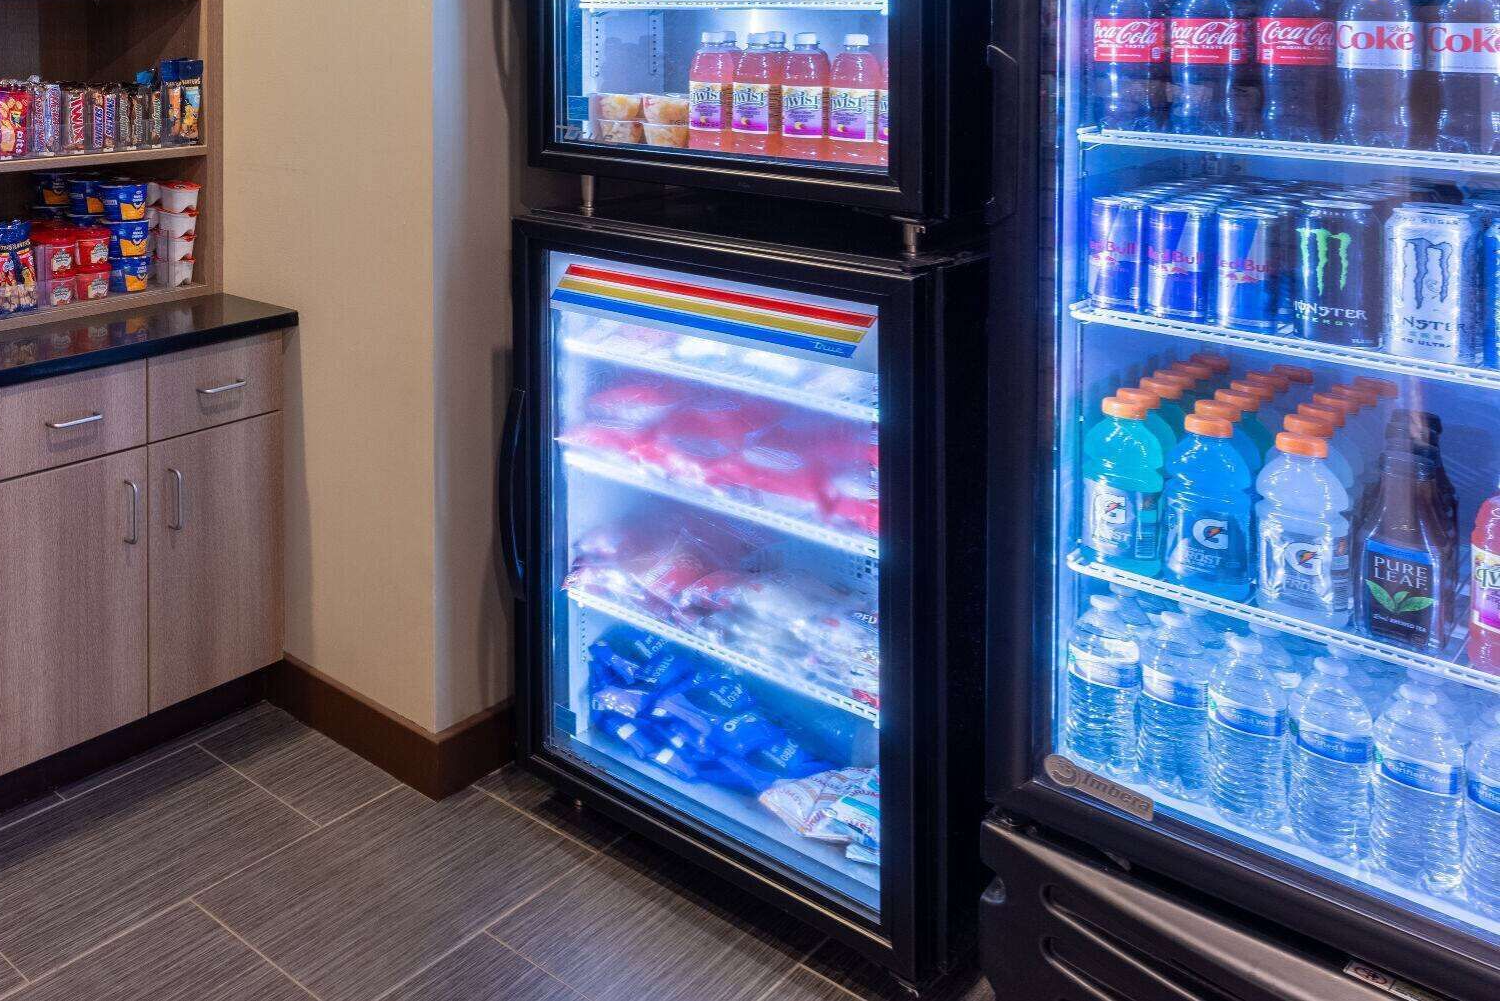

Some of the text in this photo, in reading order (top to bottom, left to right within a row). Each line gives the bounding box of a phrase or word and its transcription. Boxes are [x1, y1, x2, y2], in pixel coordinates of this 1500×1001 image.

[1337, 24, 1416, 51] Coke
[69, 92, 85, 143] TWIX
[94, 104, 104, 148] SNICKERS
[104, 98, 115, 138] SNICKERS
[1106, 241, 1138, 255] Bull
[1096, 494, 1126, 525] G
[1193, 518, 1229, 550] G
[1284, 543, 1323, 576] G
[1373, 555, 1428, 579] PURE
